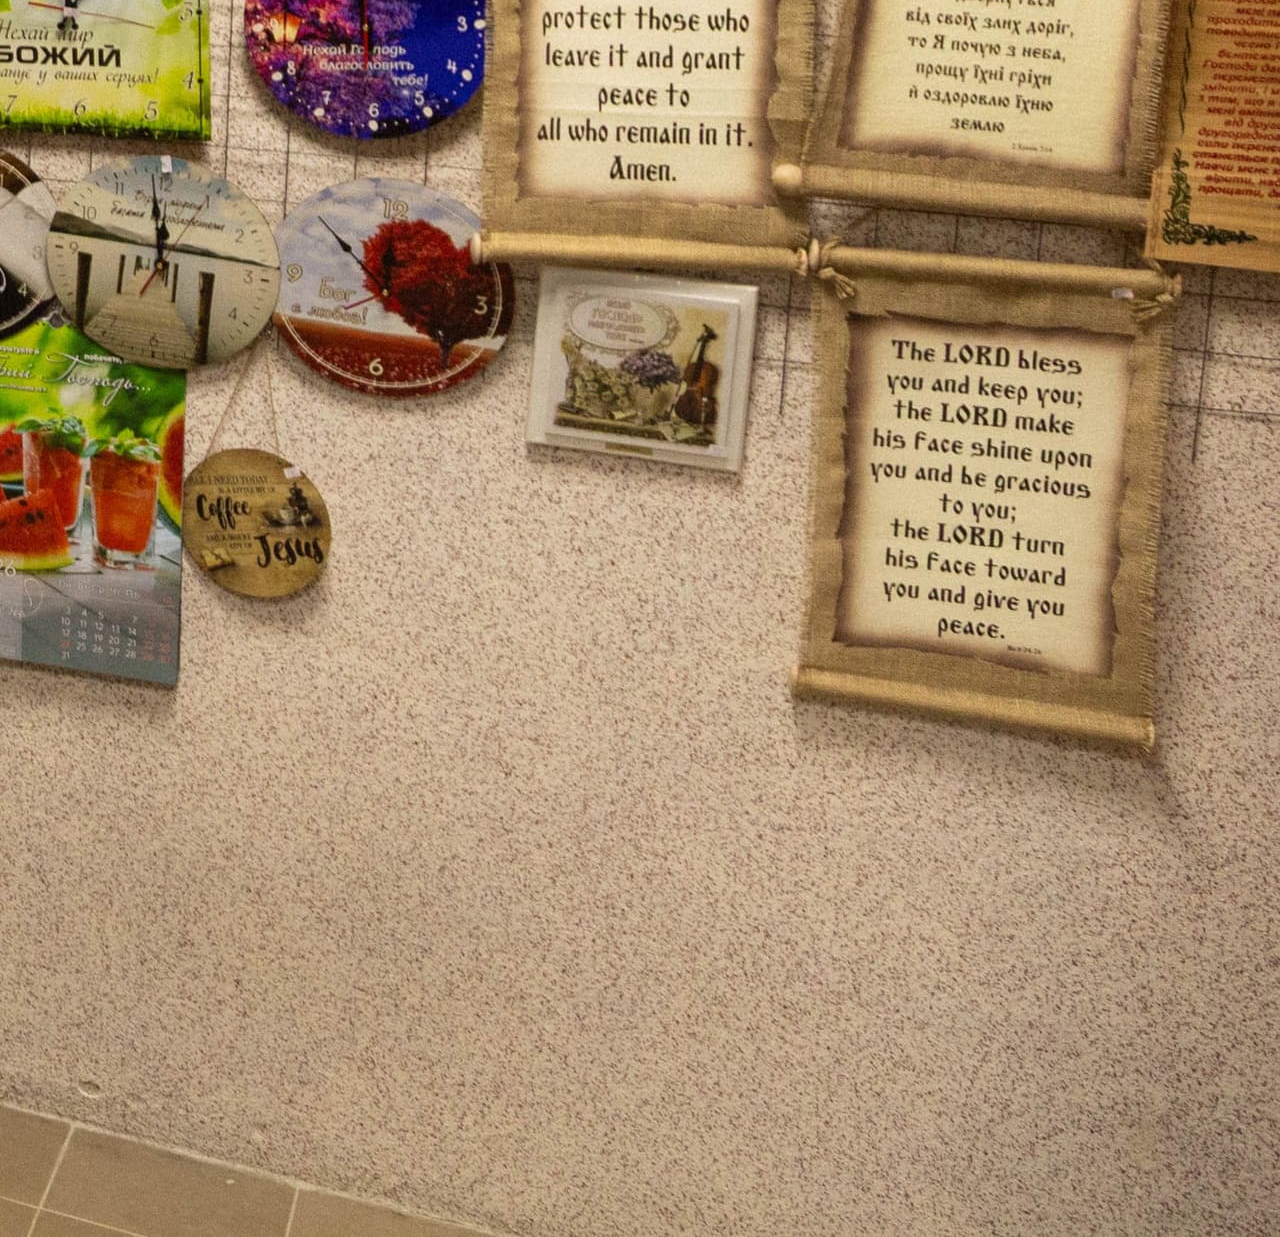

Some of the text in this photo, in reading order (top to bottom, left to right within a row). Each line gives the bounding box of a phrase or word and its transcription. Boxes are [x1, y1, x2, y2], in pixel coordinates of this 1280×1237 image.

[542, 5, 750, 36] protect those who
[545, 42, 745, 75] leave it and grant
[392, 75, 429, 86] тебе!
[598, 82, 690, 112] peace to
[537, 117, 753, 148] all who remain in it.
[609, 156, 677, 182] Amen.
[891, 339, 1083, 375] The LORD bless
[886, 374, 1084, 409] you and keep you;
[893, 400, 1075, 436] the LORD make
[872, 428, 1093, 470] his face shine upon
[871, 461, 1092, 500] you and be gracious
[196, 494, 251, 530] Coffee
[939, 493, 1017, 523] to you;
[254, 532, 324, 568] Jesus
[890, 518, 1065, 556] the LORD turn
[885, 547, 1067, 587] his face toward
[883, 580, 1065, 619] you and give you
[937, 616, 1006, 640] peace.
